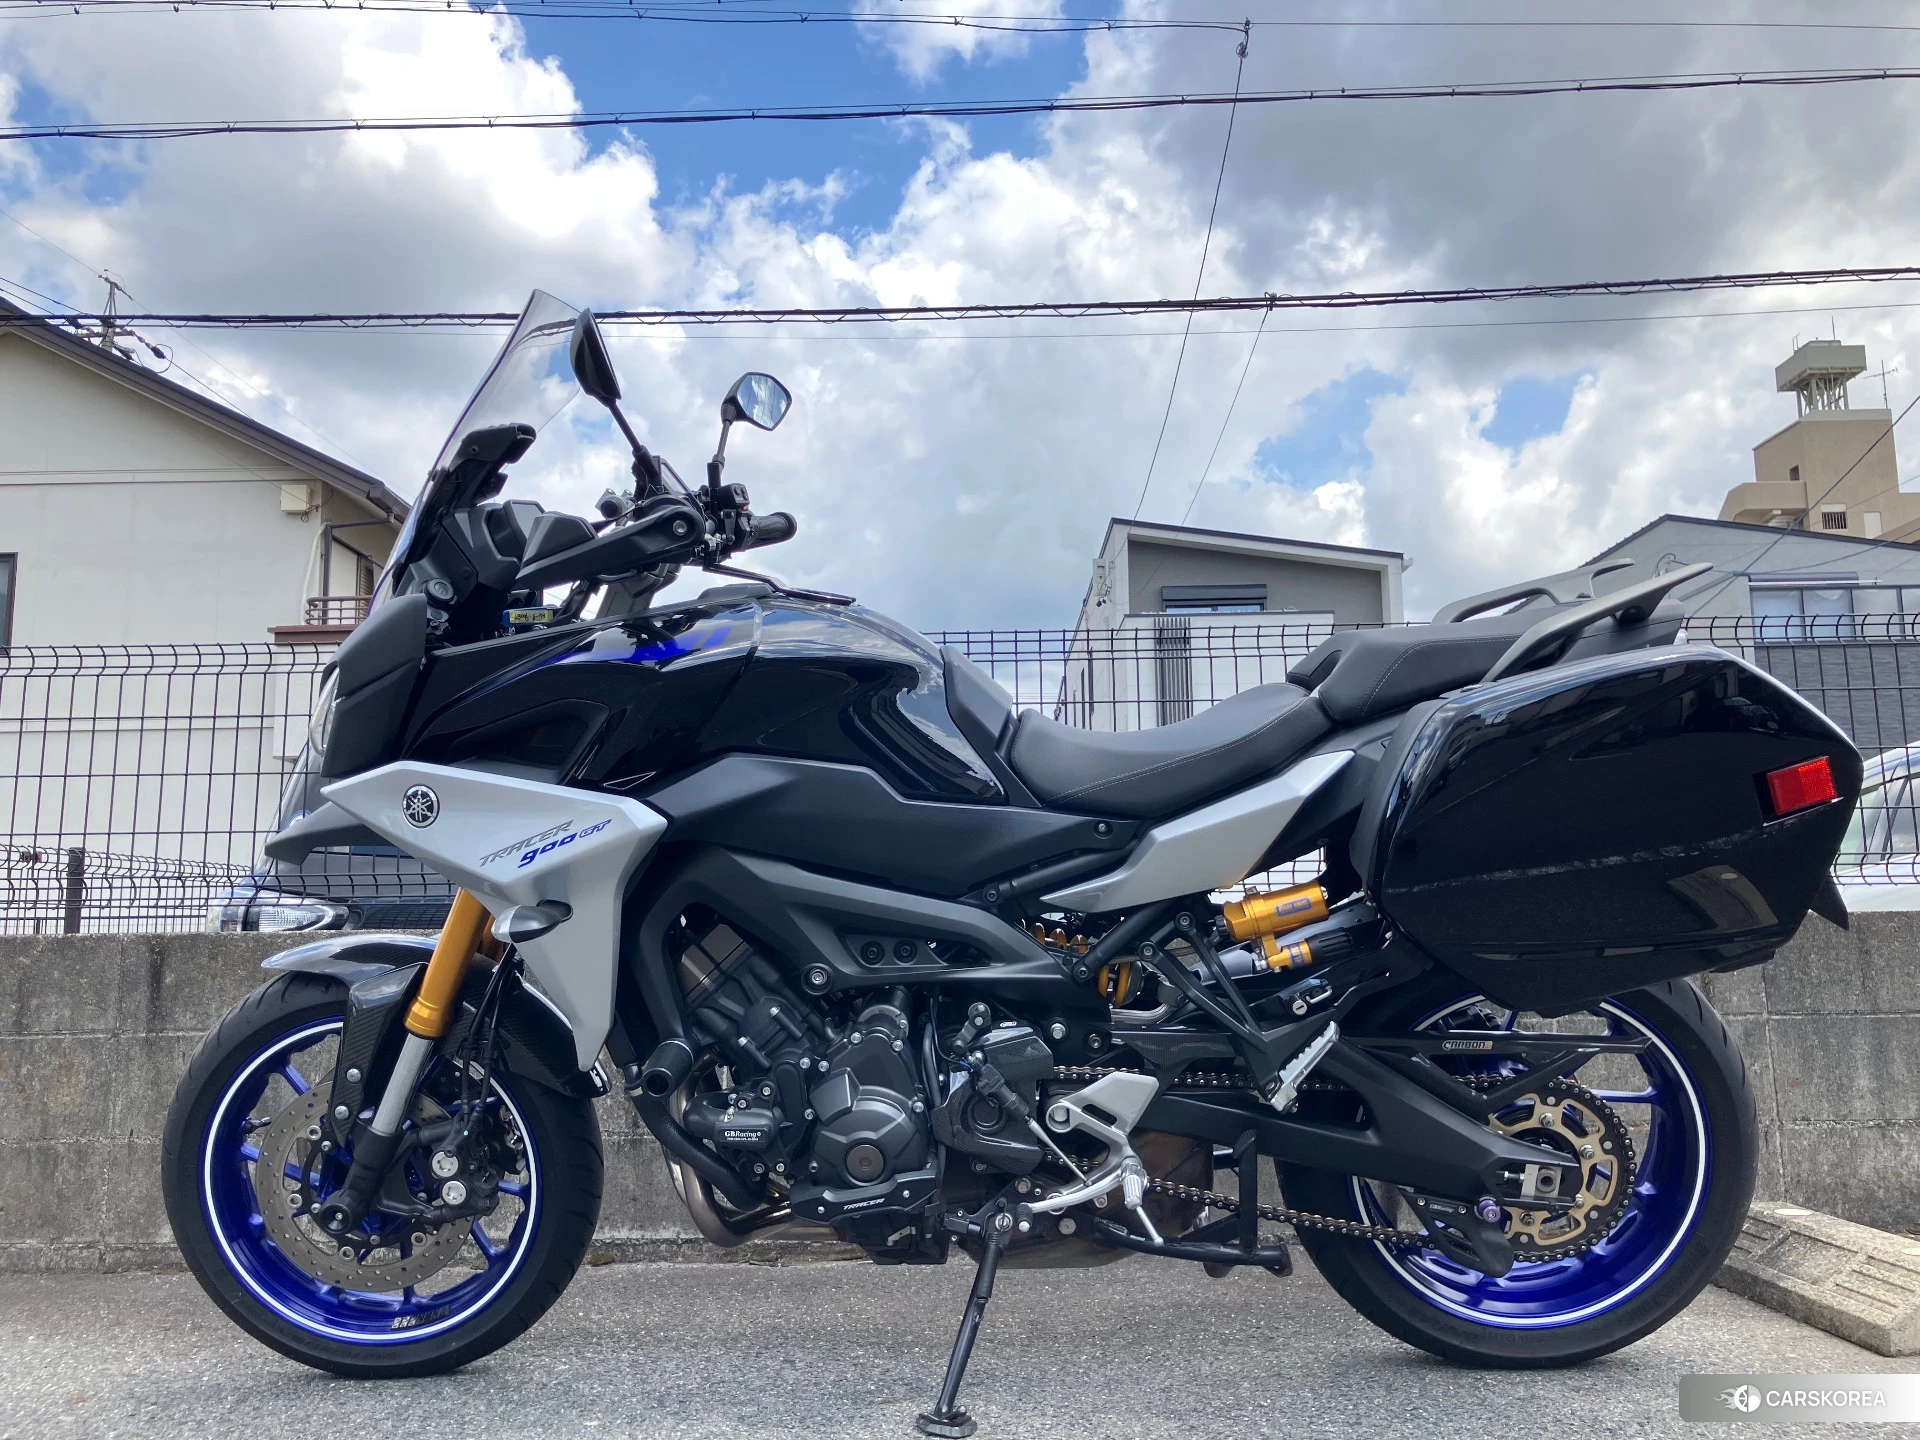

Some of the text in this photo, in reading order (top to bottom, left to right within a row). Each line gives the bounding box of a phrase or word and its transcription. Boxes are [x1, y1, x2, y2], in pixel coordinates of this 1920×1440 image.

[479, 819, 574, 867] TRACER
[517, 818, 612, 868] 900 GT
[1443, 1040, 1485, 1050] CARBON
